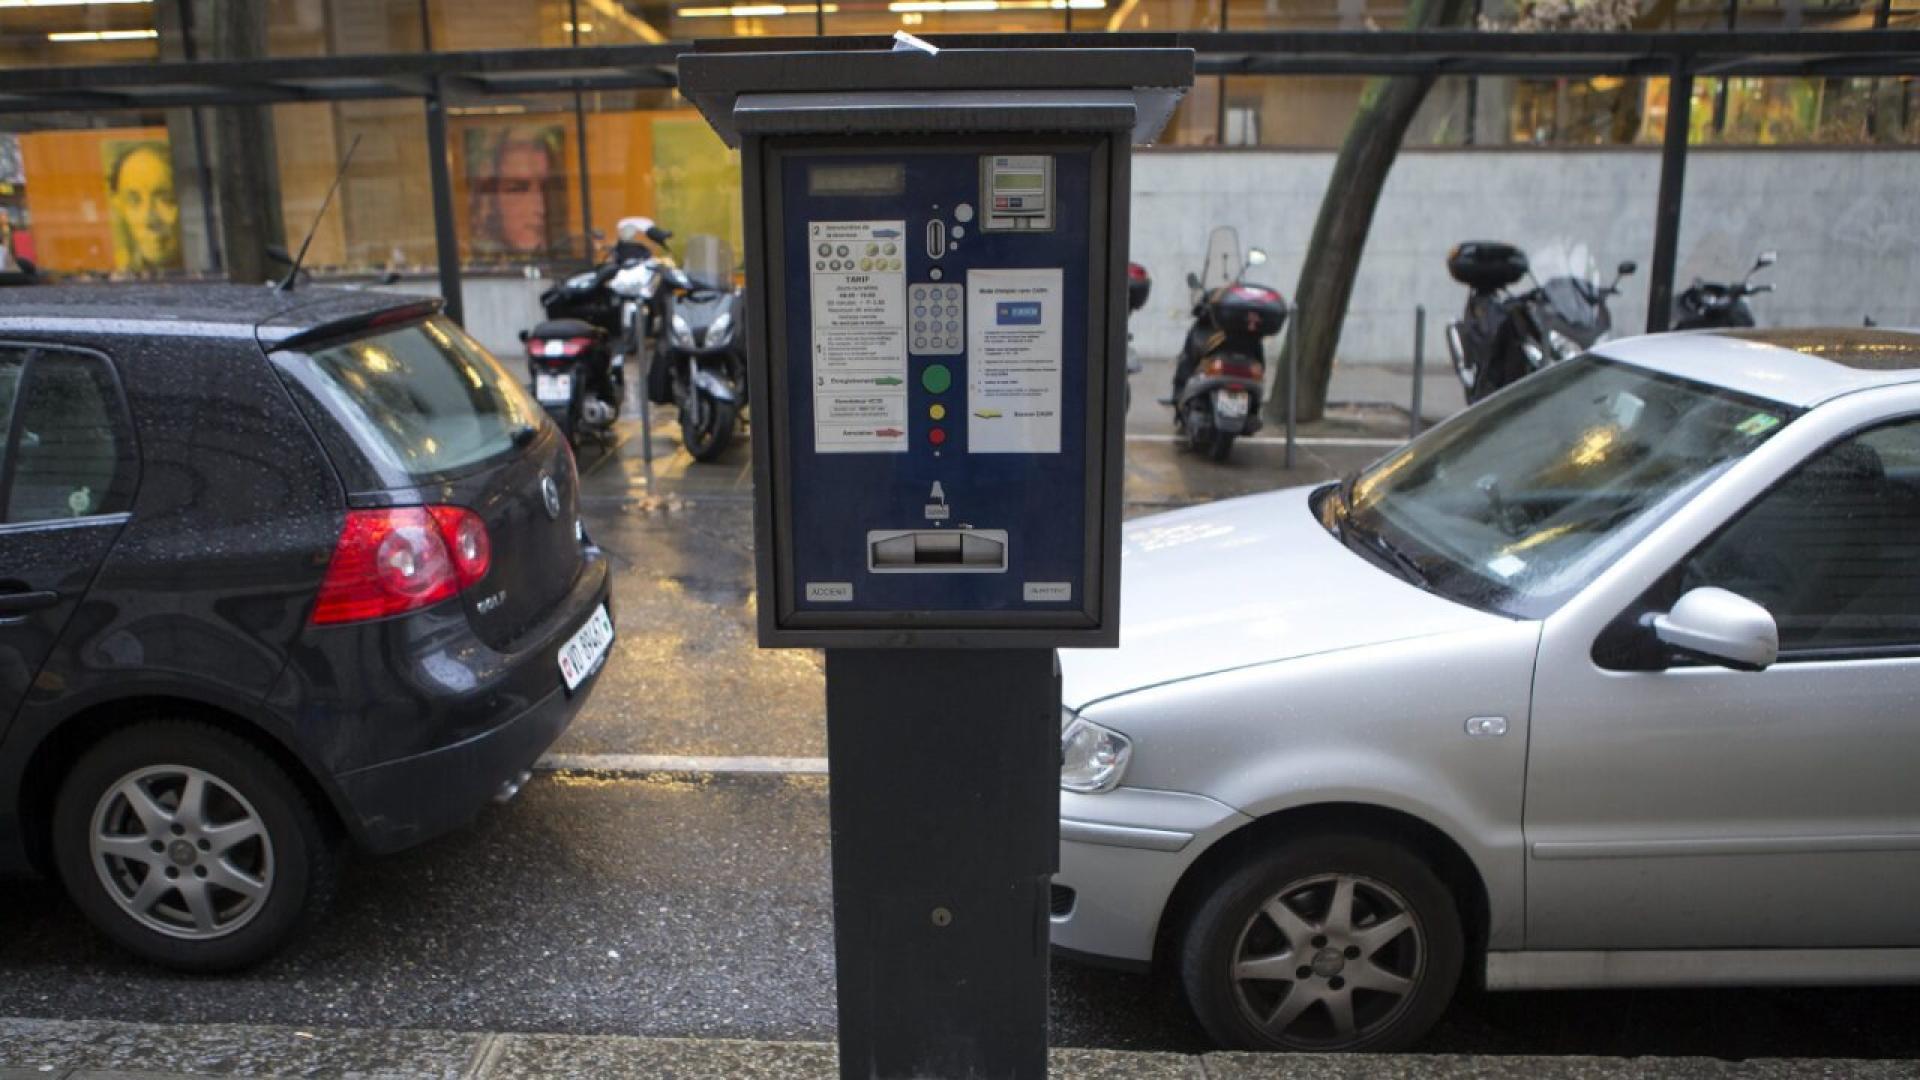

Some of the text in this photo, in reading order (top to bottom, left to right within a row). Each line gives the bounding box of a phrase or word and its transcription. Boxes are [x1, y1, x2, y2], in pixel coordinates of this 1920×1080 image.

[813, 225, 820, 236] 2
[816, 344, 821, 353] 1
[818, 376, 825, 386] 3
